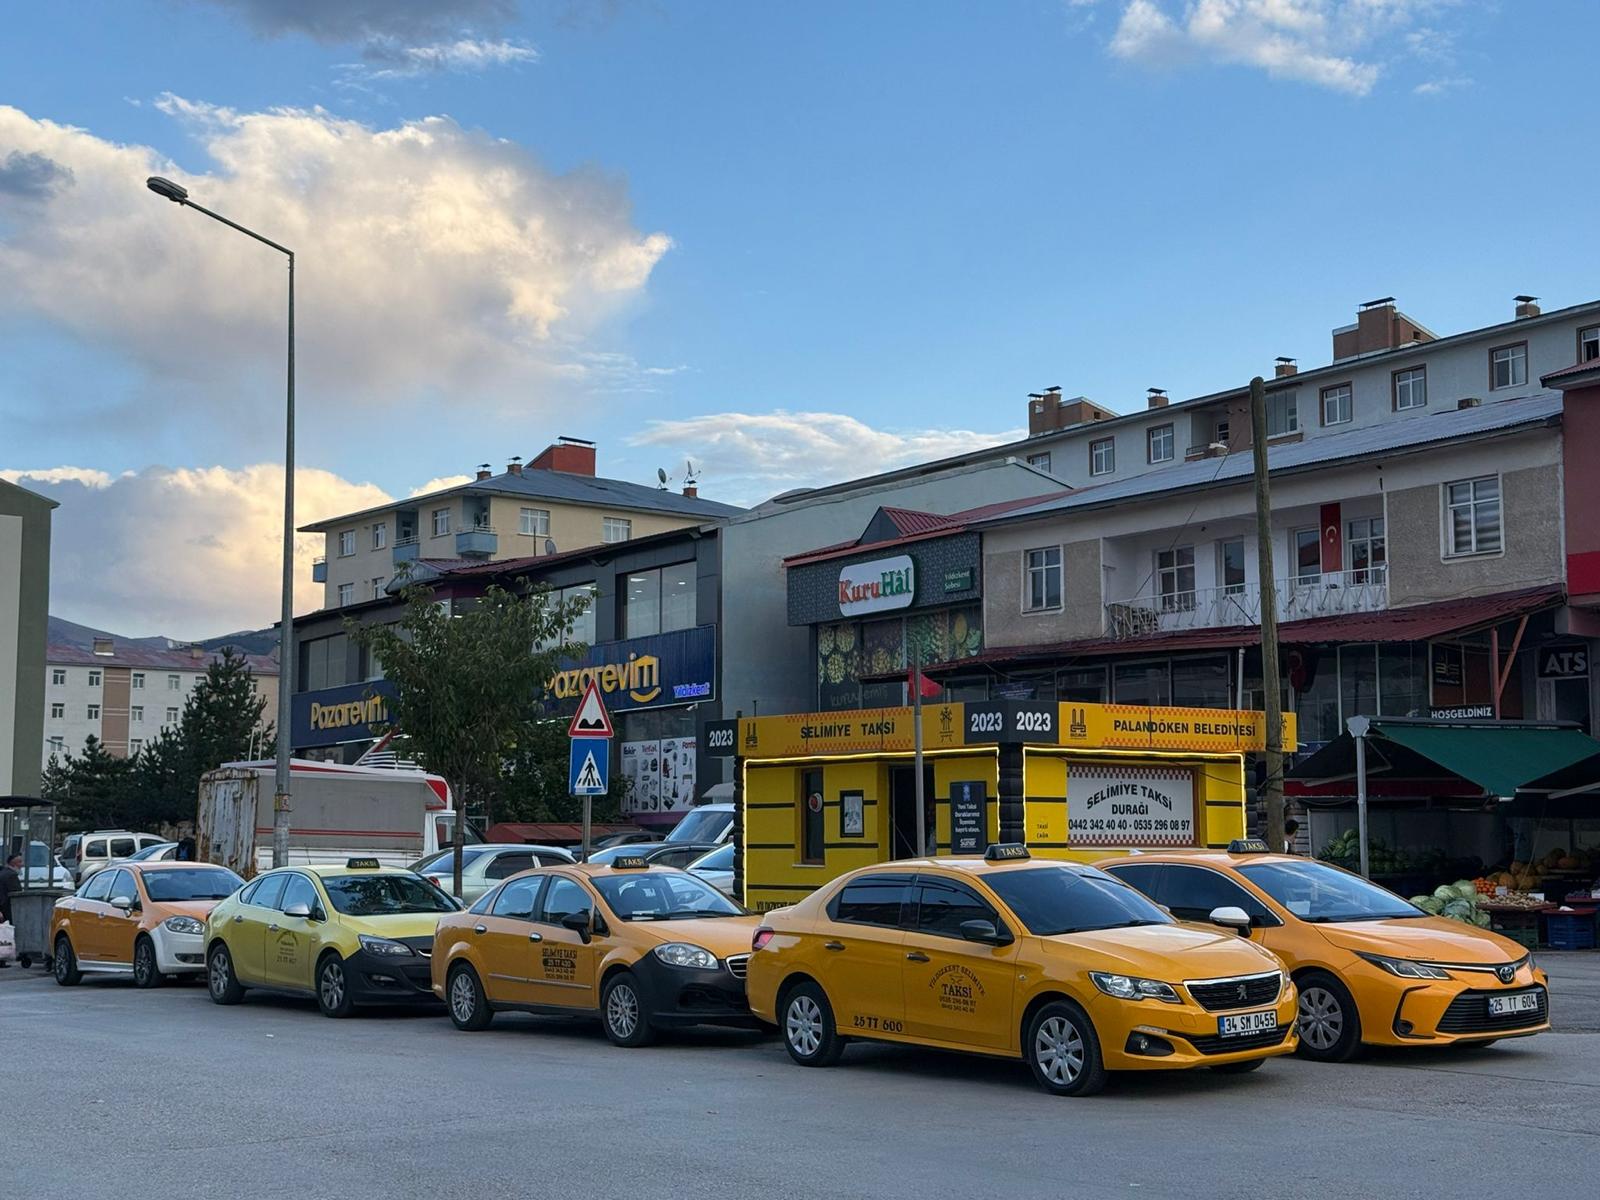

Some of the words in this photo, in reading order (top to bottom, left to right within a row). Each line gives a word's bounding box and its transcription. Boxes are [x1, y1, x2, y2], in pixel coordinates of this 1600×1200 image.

[1544, 652, 1587, 673] ATS
[800, 723, 851, 739] SELİMİYE
[861, 721, 895, 736] TAKSİ
[971, 713, 1003, 732] 2023
[1016, 711, 1051, 731] 2023
[1113, 719, 1189, 734] PALANDÖKEN
[1194, 721, 1256, 736] BELEDİYESİ
[709, 729, 734, 747] 2023
[1086, 781, 1138, 810] SELİMİYE
[1140, 785, 1173, 811] TAKSİ
[1111, 801, 1149, 815] DURAĞI
[1068, 819, 1087, 831] 0442
[1089, 819, 1104, 831] 342
[1105, 819, 1116, 830] 40
[1117, 819, 1128, 830] 40
[1133, 819, 1153, 830] 0535
[1154, 819, 1168, 830] 296
[1169, 819, 1180, 830] 08
[1181, 819, 1190, 830] 97
[942, 983, 973, 999] TAKSİ
[1494, 998, 1503, 1011] 25
[1508, 997, 1517, 1010] TT
[1522, 995, 1536, 1008] 604
[853, 1015, 865, 1028] 25
[866, 1016, 878, 1029] TT
[882, 1017, 903, 1032] 600
[1226, 1017, 1237, 1031] 34
[1240, 1015, 1251, 1030] SM
[1254, 1012, 1275, 1028] 0455
